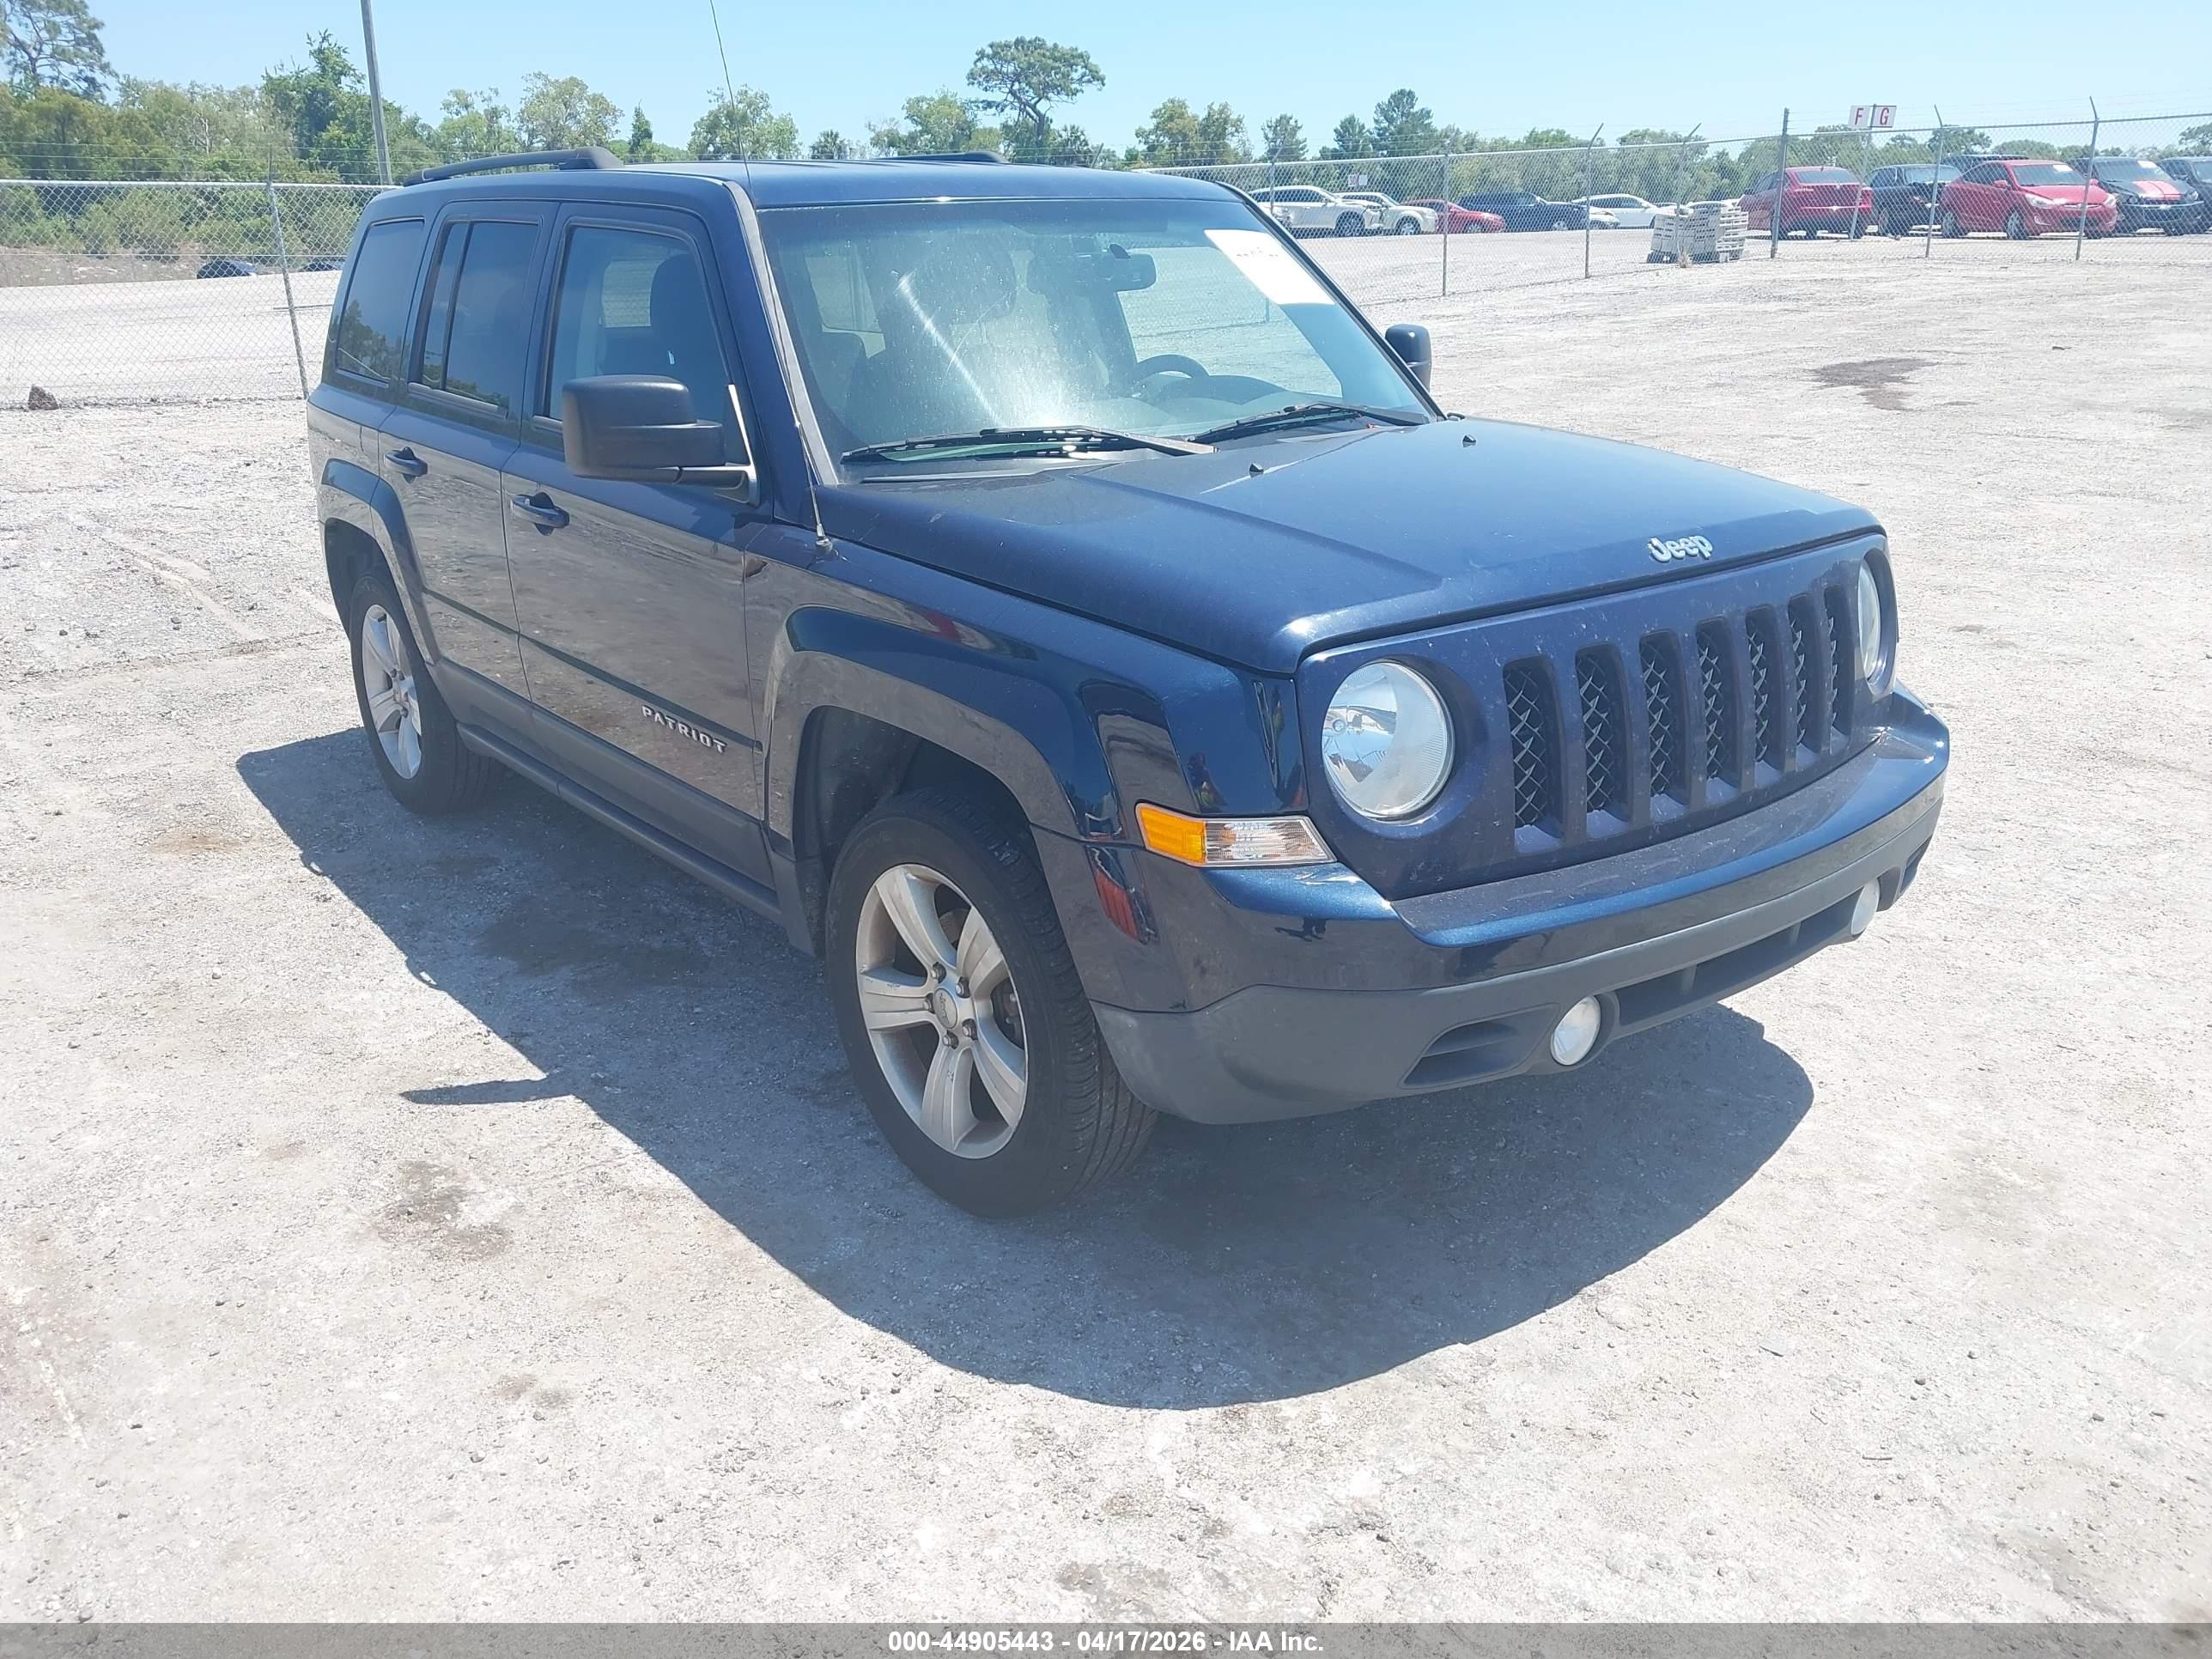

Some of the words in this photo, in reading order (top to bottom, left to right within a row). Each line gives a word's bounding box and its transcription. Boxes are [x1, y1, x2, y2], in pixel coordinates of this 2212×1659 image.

[1854, 107, 1864, 125] F
[1879, 107, 1890, 125] G
[1647, 535, 1713, 563] Jeep
[641, 704, 727, 755] PATRIOT
